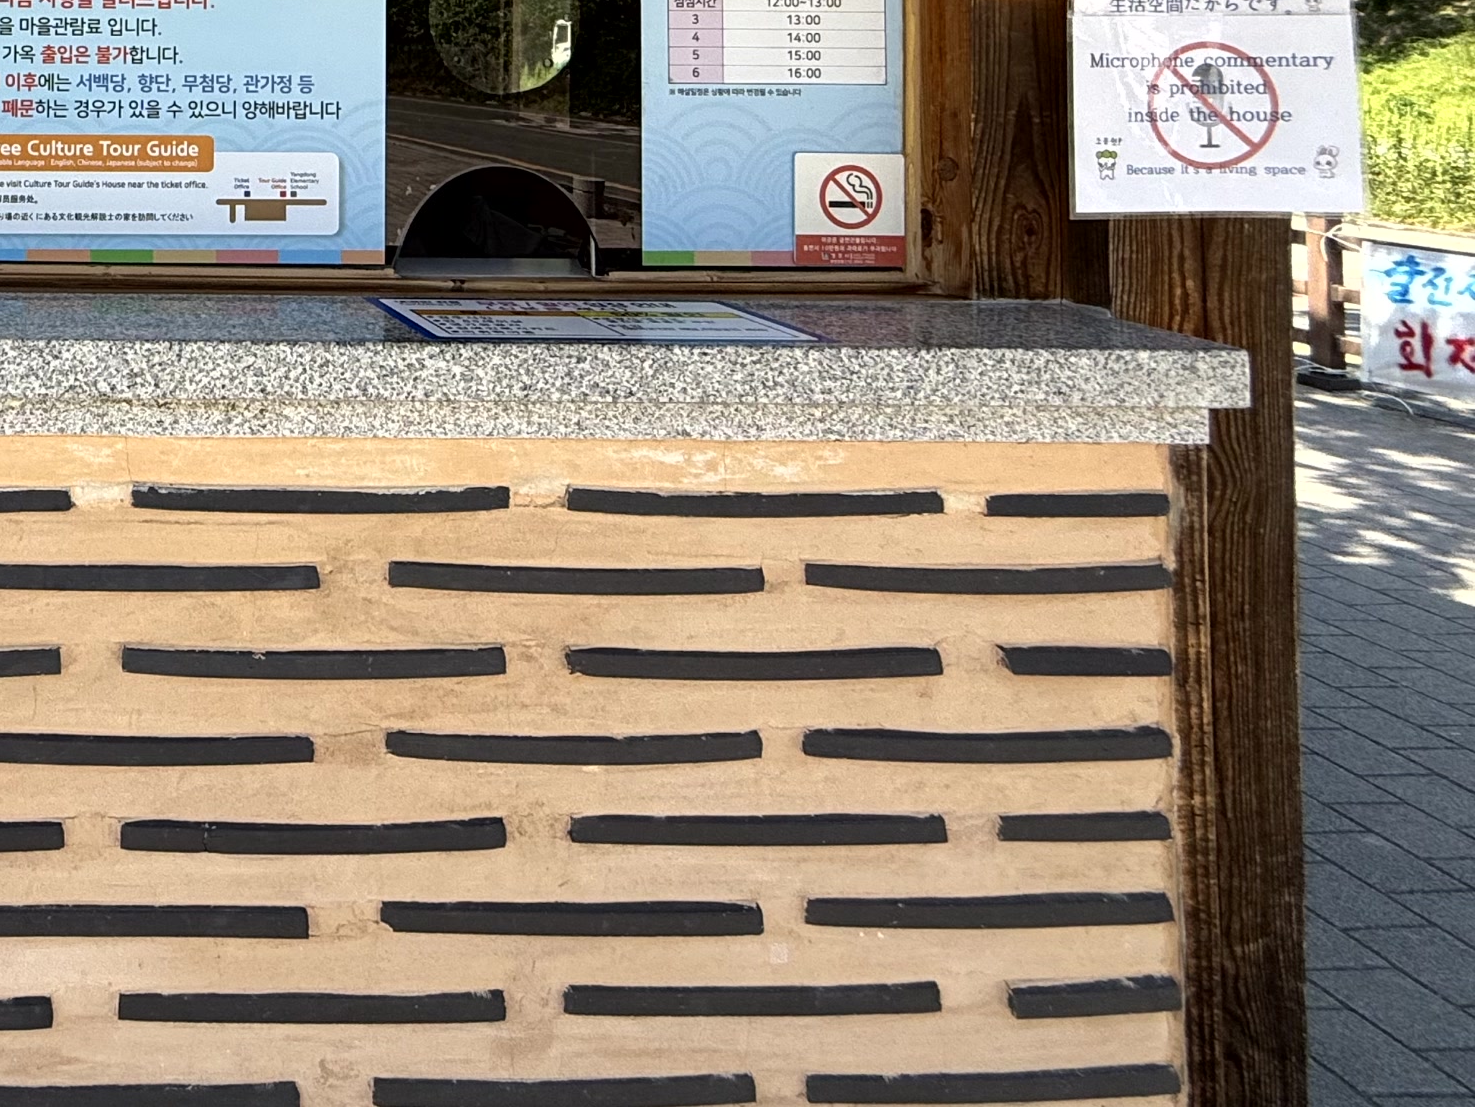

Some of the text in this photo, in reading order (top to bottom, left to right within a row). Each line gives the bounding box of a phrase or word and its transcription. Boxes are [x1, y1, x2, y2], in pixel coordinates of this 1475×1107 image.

[786, 13, 821, 26] 13:00
[786, 31, 821, 44] 14:00
[787, 49, 821, 61] 15:00
[1090, 53, 1333, 70] Microphone commentary
[787, 67, 822, 79] 16:00
[1146, 81, 1268, 97] is prohibited
[1128, 107, 1292, 123] inside the house
[26, 139, 93, 156] Culture
[98, 140, 141, 156] Tour
[146, 139, 199, 157] Guide
[1126, 164, 1174, 175] Because
[1220, 164, 1257, 177] living
[1264, 165, 1306, 177] space
[5, 179, 22, 188] visit
[22, 179, 52, 188] Culture
[53, 179, 71, 188] Tour
[71, 179, 101, 189] Guide's
[101, 180, 126, 189] House
[126, 181, 145, 189] near
[145, 180, 160, 189] the
[160, 179, 183, 189] ticket
[183, 179, 208, 189] office.
